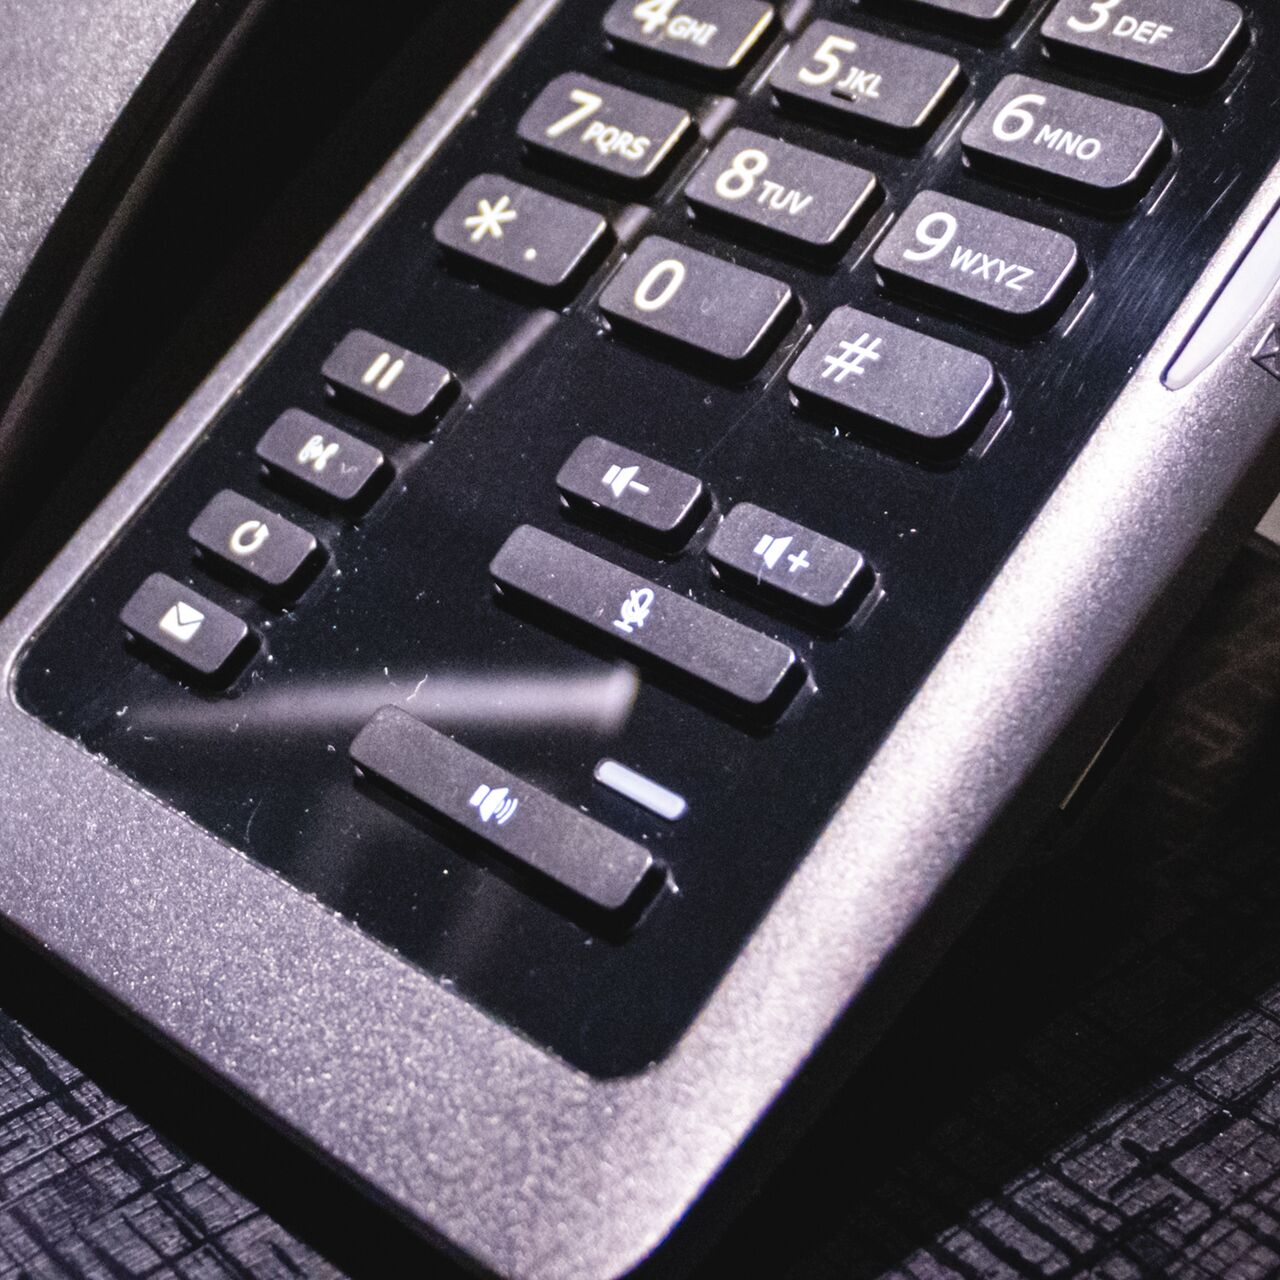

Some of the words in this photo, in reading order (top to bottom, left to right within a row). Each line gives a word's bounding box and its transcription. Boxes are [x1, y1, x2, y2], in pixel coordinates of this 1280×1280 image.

[666, 15, 718, 46] GHI
[1112, 14, 1174, 47] DEF
[797, 34, 859, 87] 5
[837, 66, 883, 99] JKL
[545, 88, 602, 141] 7
[581, 120, 651, 161] PQRS
[991, 94, 1047, 142] 6
[1033, 123, 1103, 162] MNO
[714, 147, 769, 200] 8
[757, 179, 814, 216] TUV
[633, 258, 686, 311] 0
[902, 211, 957, 263] 9
[949, 245, 1035, 293] WXYZ
[820, 332, 883, 384] #
